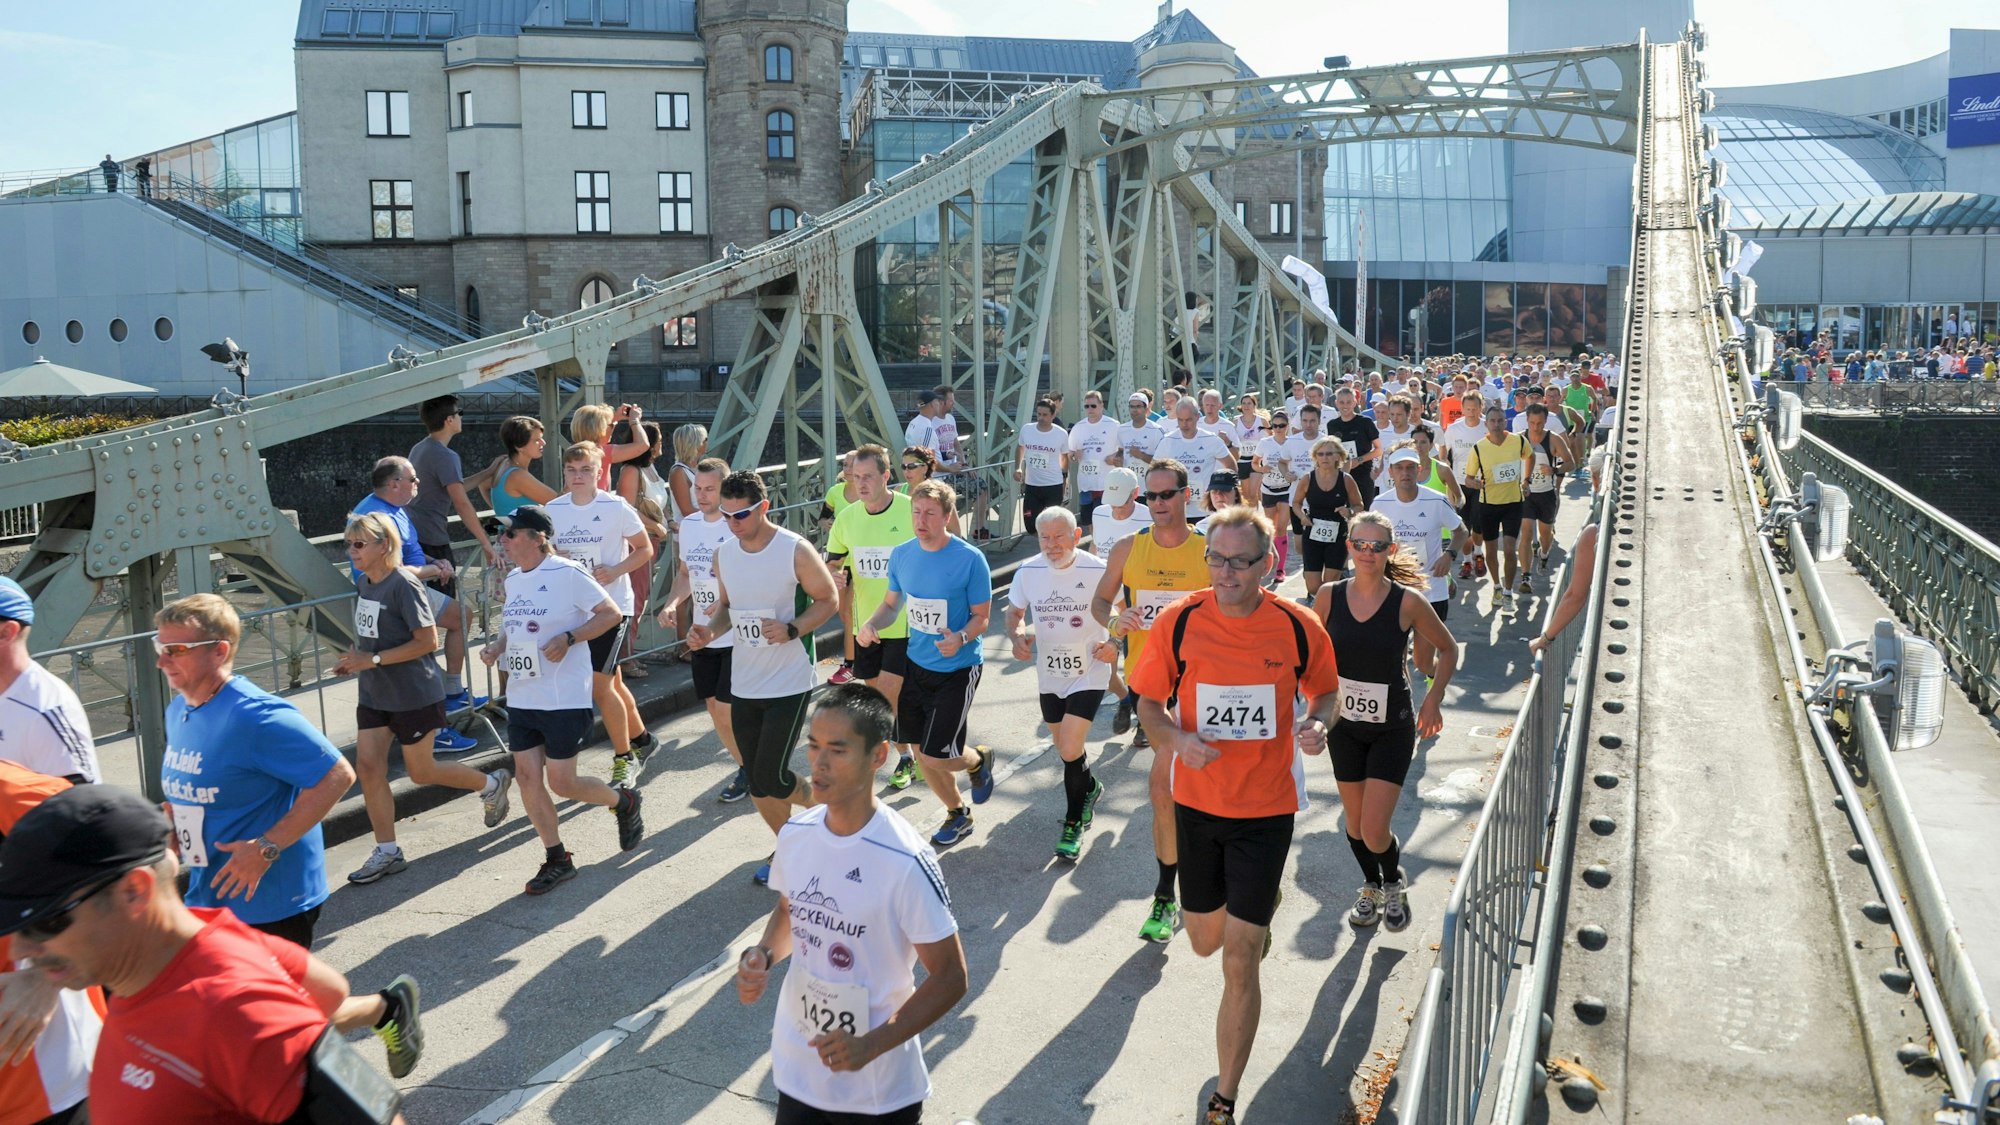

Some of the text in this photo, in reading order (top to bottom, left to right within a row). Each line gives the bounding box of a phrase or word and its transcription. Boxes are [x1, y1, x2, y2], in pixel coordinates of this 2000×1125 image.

[1025, 444, 1056, 453] NISSAN
[1029, 457, 1046, 466] 2773
[1499, 468, 1516, 479] 563
[1315, 527, 1333, 538] 493
[858, 558, 889, 571] 1107
[909, 608, 941, 626] 1917
[1046, 655, 1082, 670] 2185
[1345, 695, 1379, 714] 059
[1206, 705, 1267, 727] 2474
[801, 993, 856, 1036] 1428
